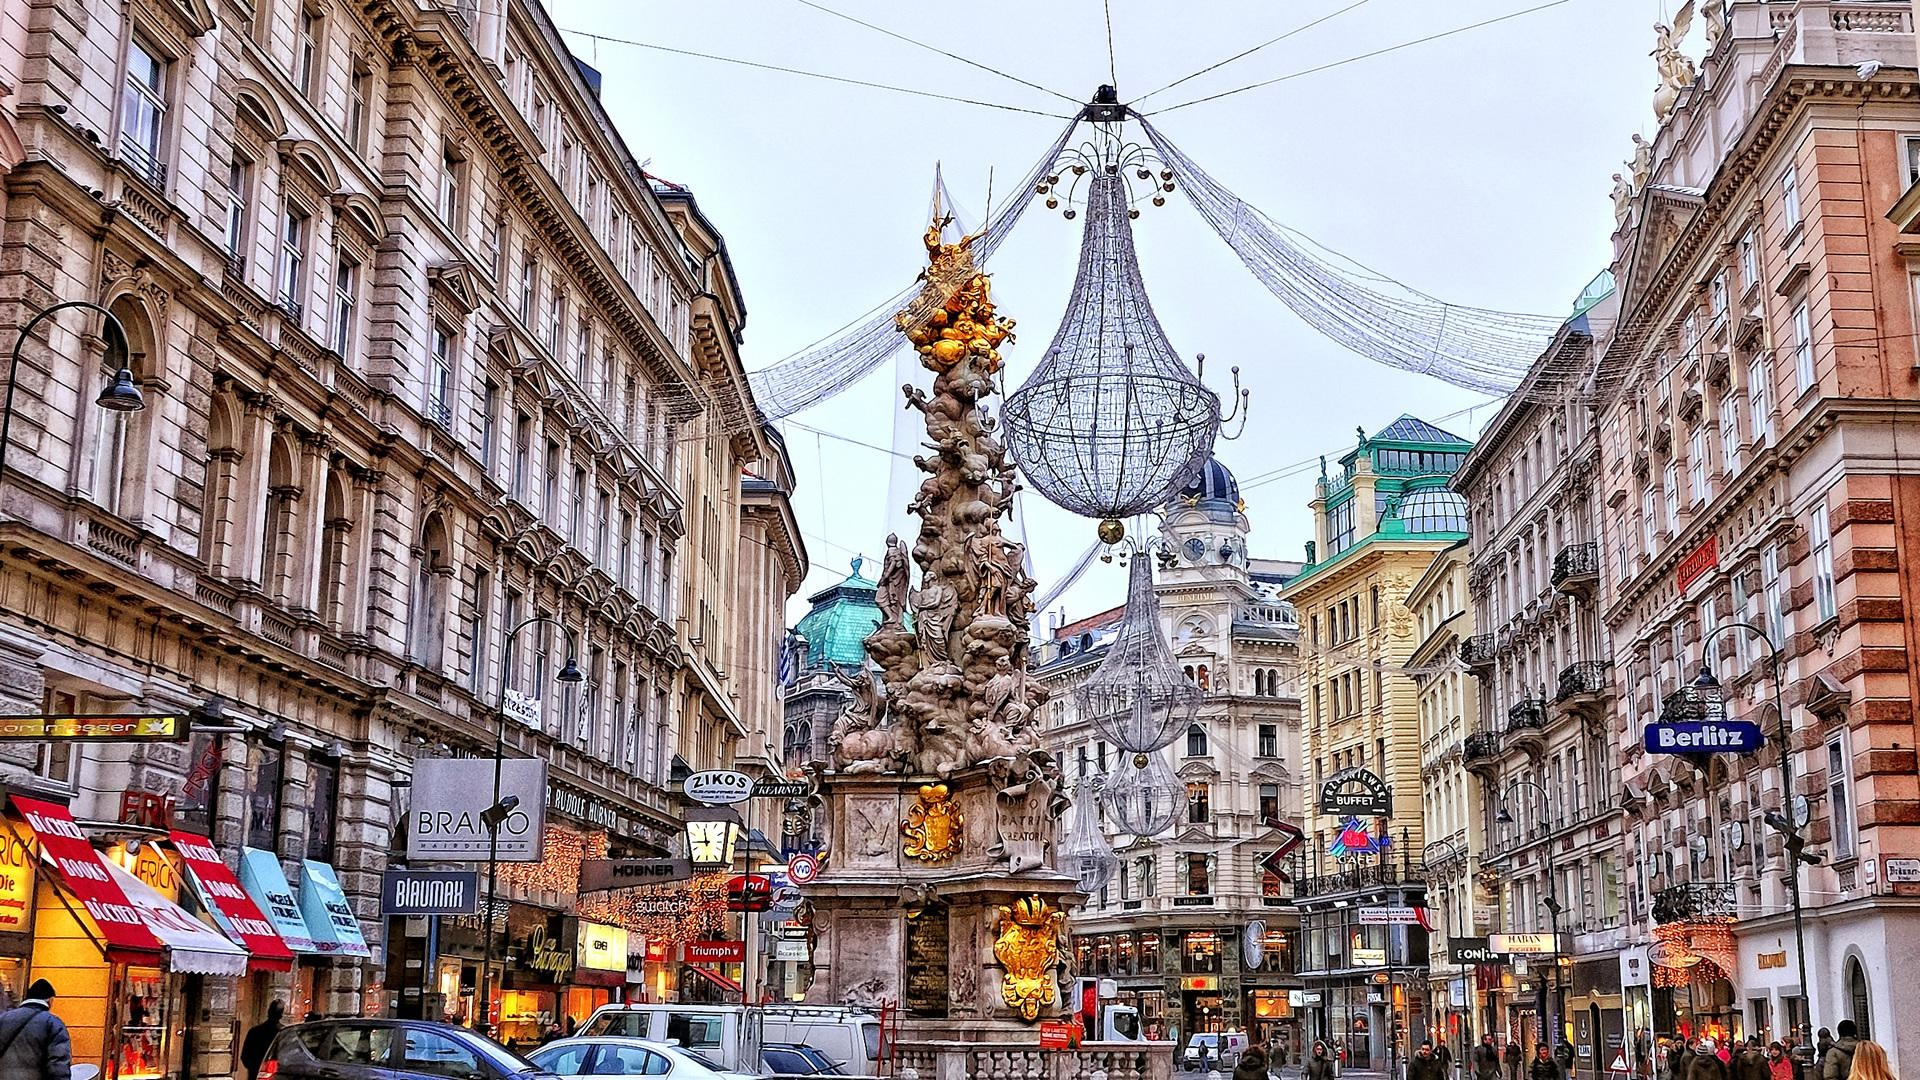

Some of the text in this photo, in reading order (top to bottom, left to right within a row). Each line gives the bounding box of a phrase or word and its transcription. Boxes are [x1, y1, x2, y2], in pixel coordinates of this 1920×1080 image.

[0, 723, 137, 733] ommesser
[1659, 726, 1743, 746] Berlitz
[693, 773, 747, 788] ZIKOS
[759, 785, 807, 795] KEARNEY
[1336, 796, 1374, 806] BUFFET
[555, 789, 585, 820] RUDOLF
[588, 801, 617, 830] HÜBNER
[418, 811, 530, 835] BRAMO
[1002, 815, 1041, 825] PATRI
[59, 857, 109, 882] BOOKS
[140, 860, 179, 890] FRICK
[634, 897, 688, 914] swatch
[691, 945, 731, 957] Triumph
